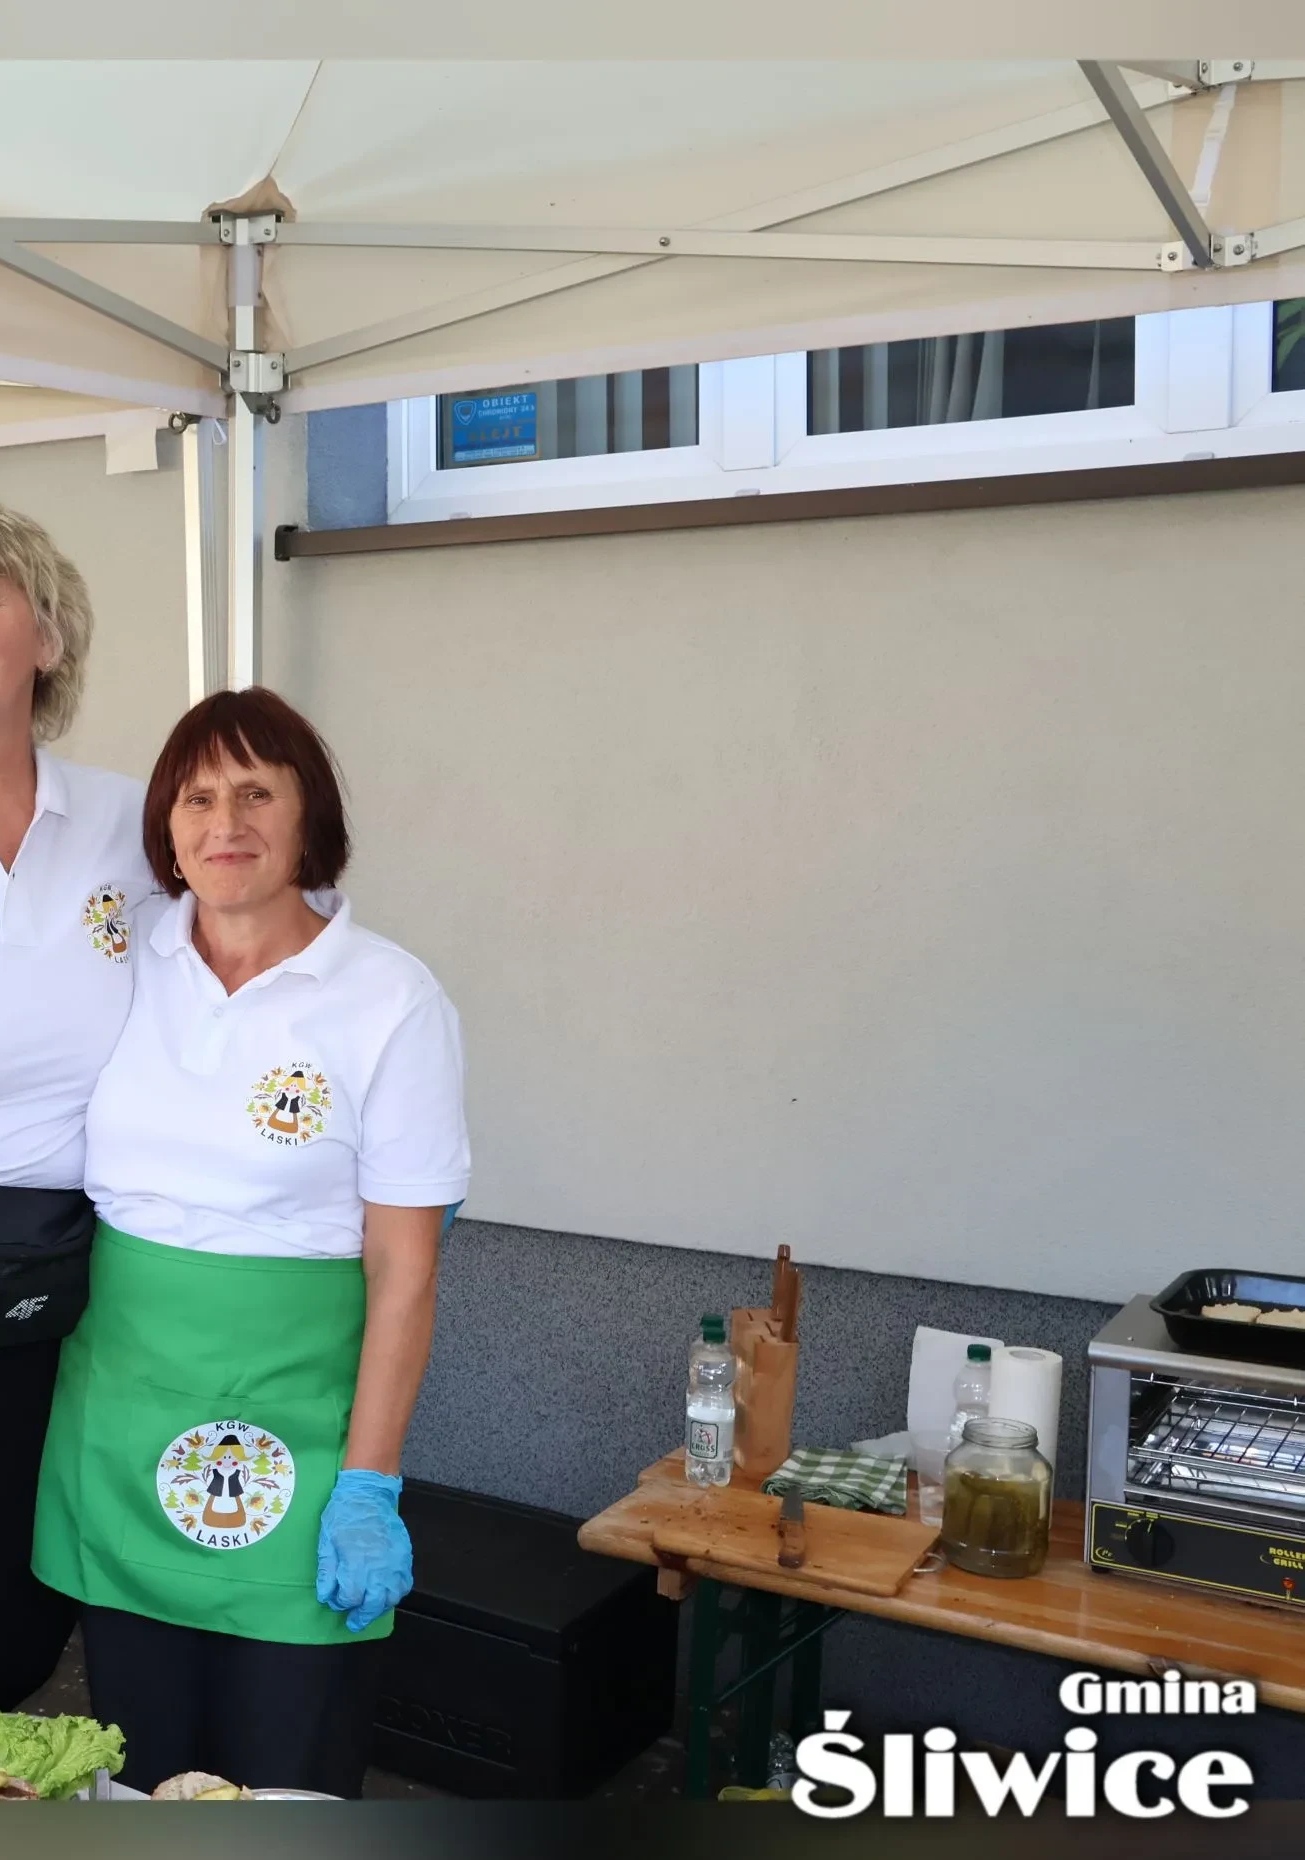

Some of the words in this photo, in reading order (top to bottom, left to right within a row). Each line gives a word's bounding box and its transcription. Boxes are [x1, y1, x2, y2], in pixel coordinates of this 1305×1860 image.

[482, 394, 529, 409] OBIEKT
[291, 1061, 312, 1069] KGW
[260, 1128, 298, 1146] LASKI
[215, 1420, 250, 1432] KGW
[196, 1529, 249, 1548] LASKI
[1273, 1557, 1304, 1570] GRILL
